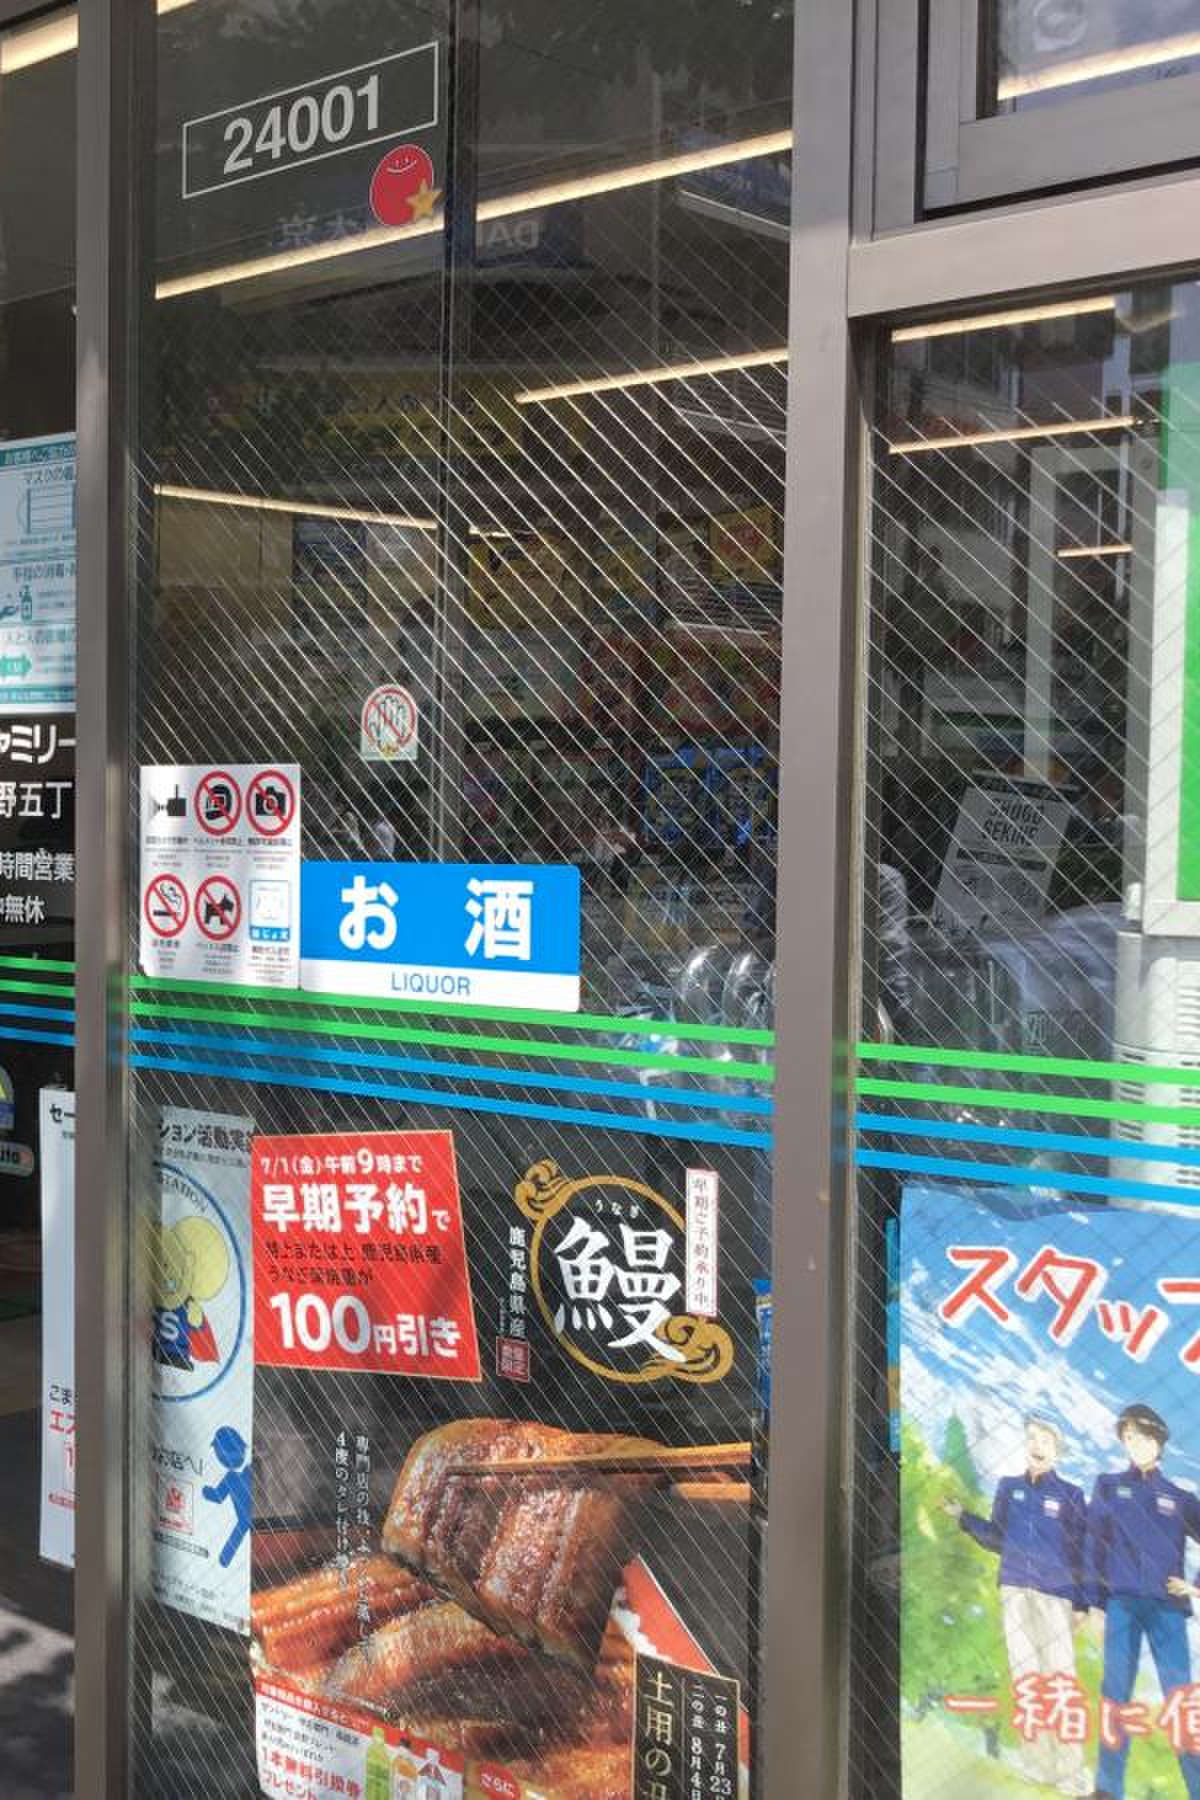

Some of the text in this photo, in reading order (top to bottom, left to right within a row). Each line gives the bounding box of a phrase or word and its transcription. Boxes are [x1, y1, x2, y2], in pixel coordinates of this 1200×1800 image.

[223, 75, 379, 175] 24001
[339, 875, 534, 961] お酒
[391, 972, 471, 996] LIQUOR
[262, 1182, 451, 1235] 早期予約で
[596, 1199, 640, 1219] うなぎ
[554, 1215, 687, 1362] 鰻
[270, 1291, 462, 1358] 100円引き
